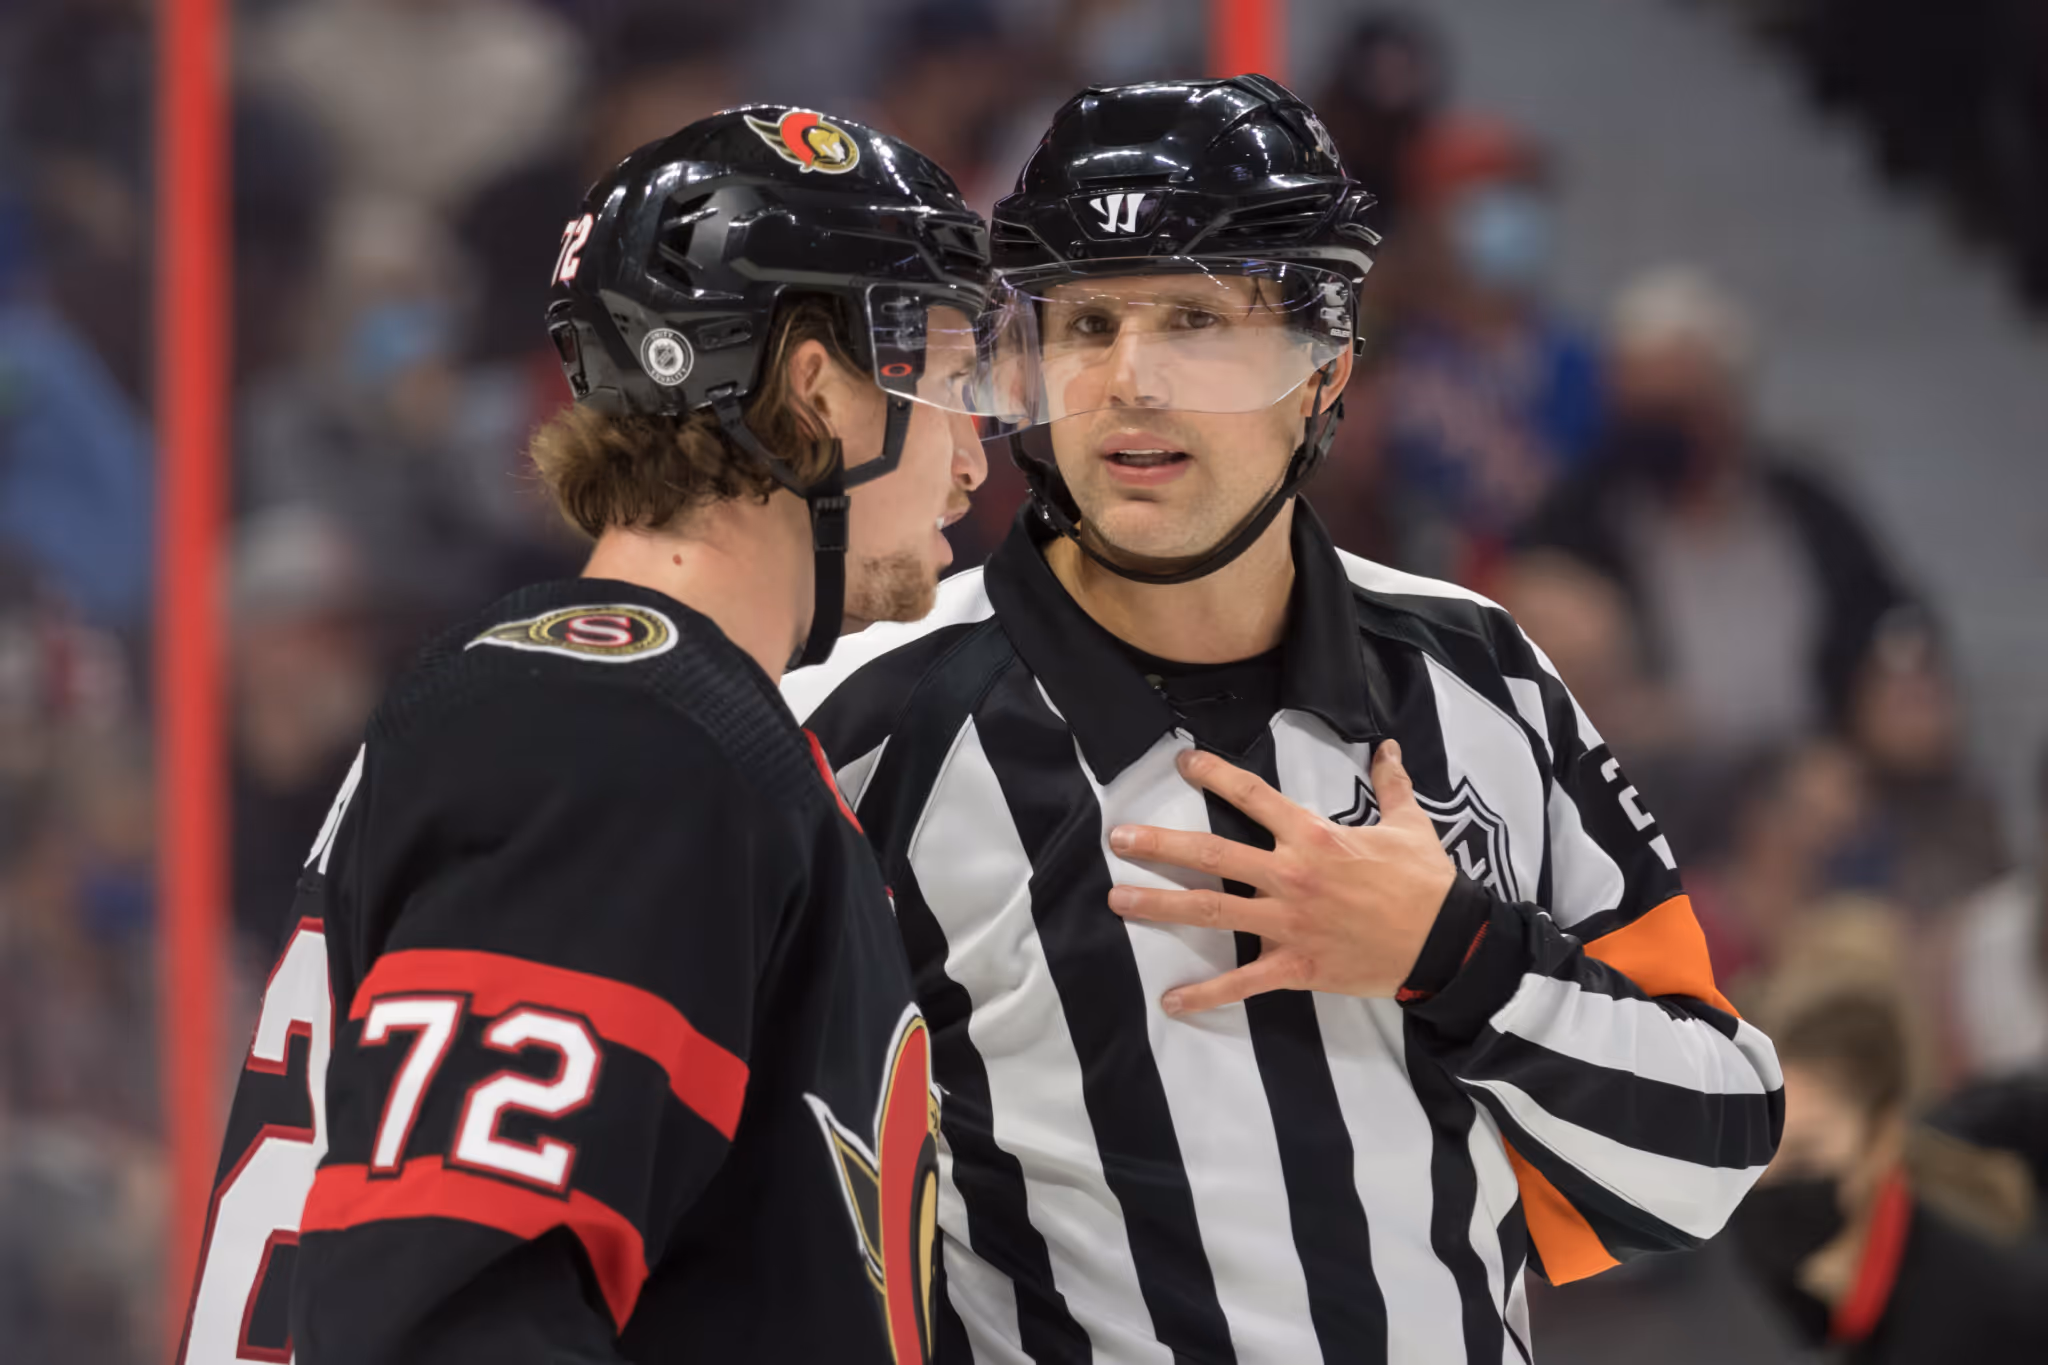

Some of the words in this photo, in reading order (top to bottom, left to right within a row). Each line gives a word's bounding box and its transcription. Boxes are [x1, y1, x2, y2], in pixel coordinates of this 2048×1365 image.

[552, 213, 594, 286] 72
[566, 616, 632, 647] S
[358, 992, 604, 1196] 72
